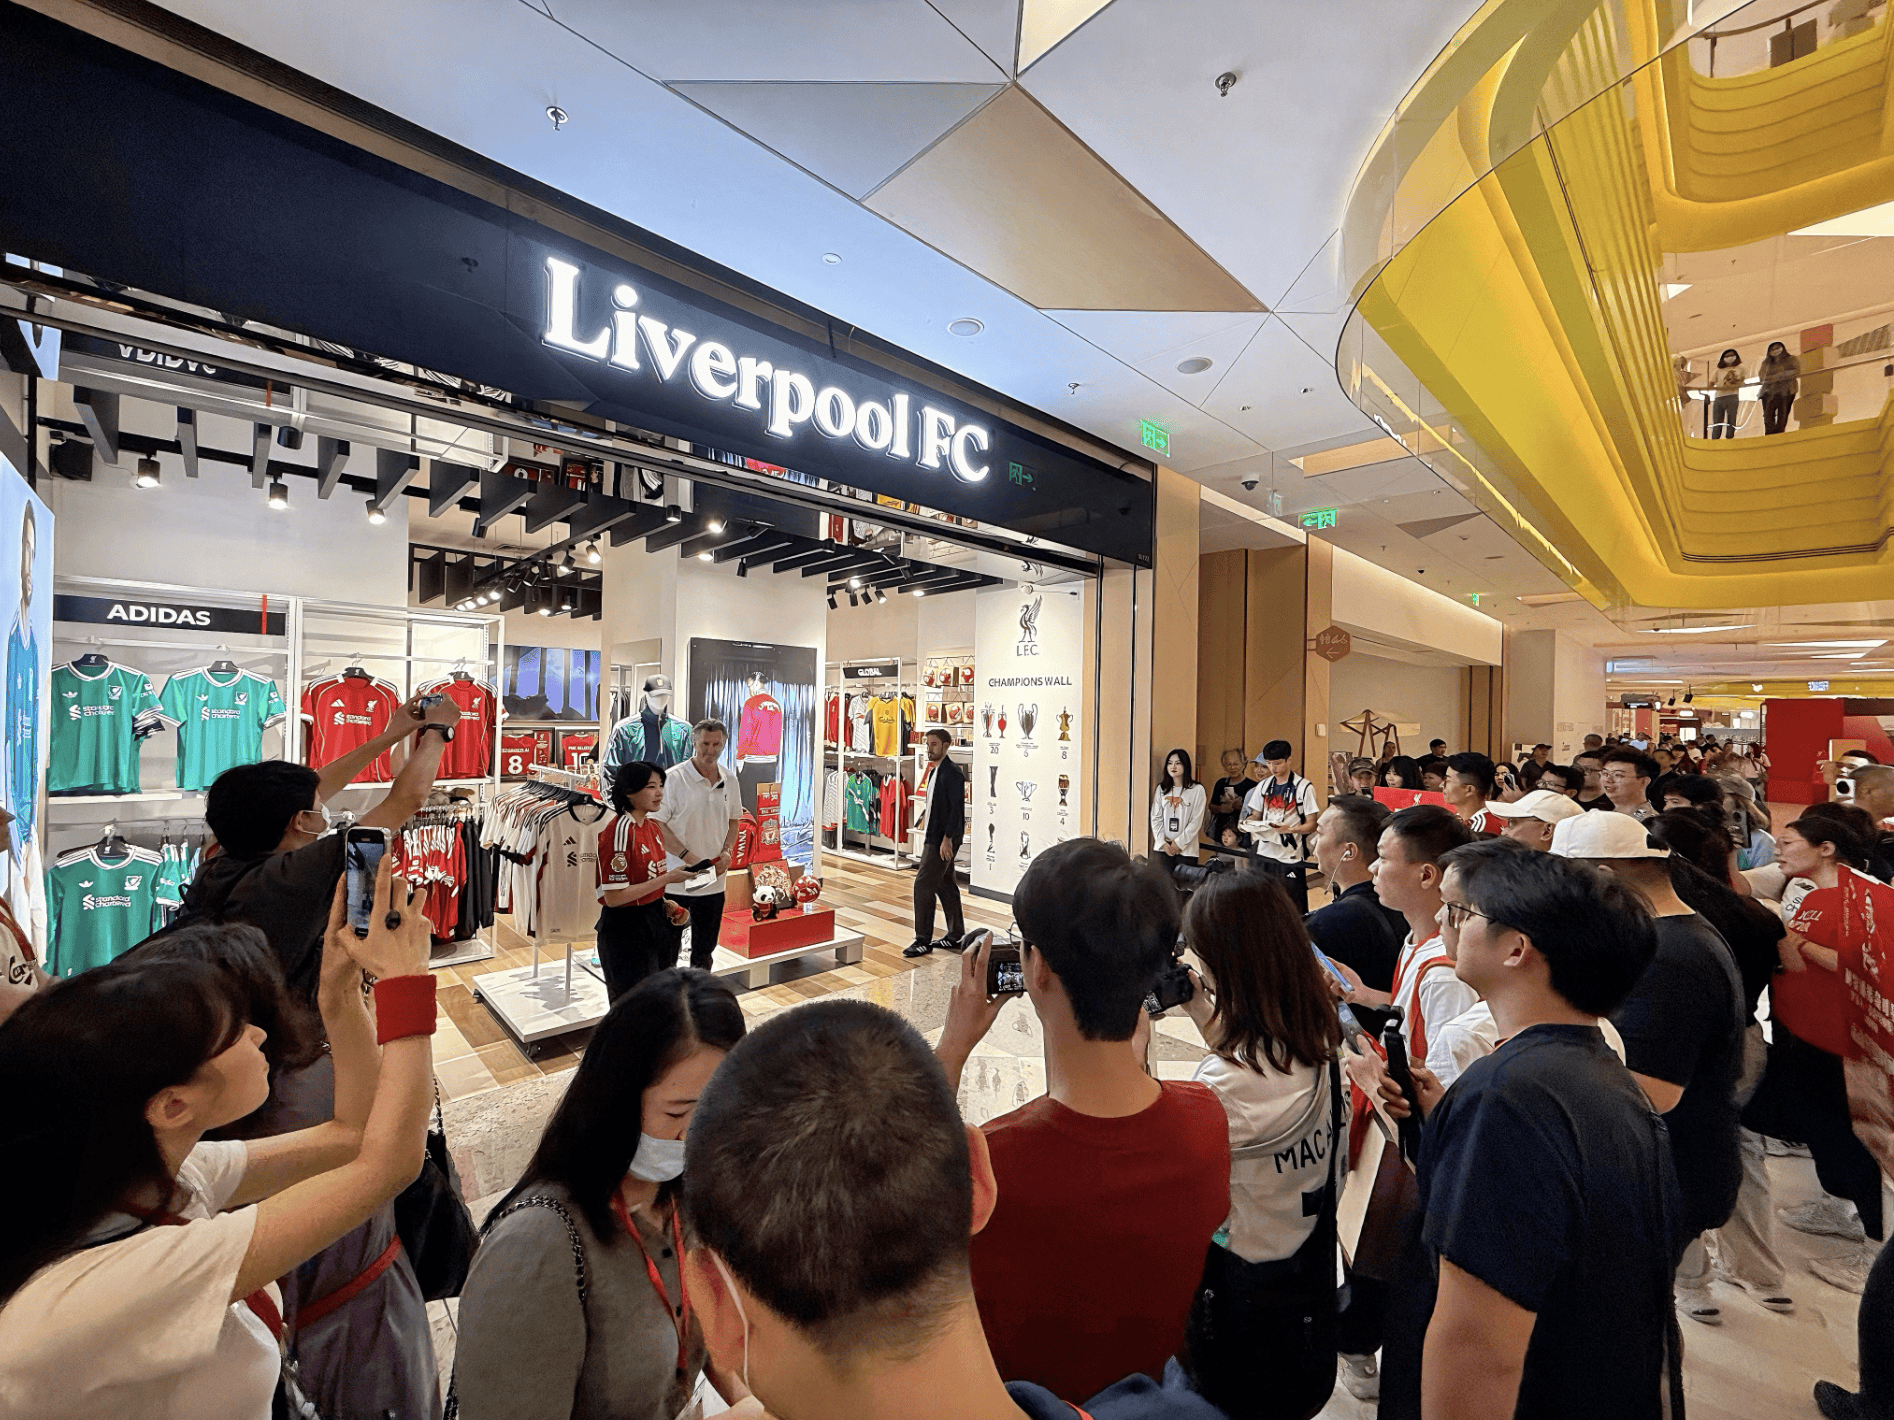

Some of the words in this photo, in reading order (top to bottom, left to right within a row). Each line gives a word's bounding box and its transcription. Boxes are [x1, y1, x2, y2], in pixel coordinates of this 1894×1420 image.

[544, 257, 910, 460] Liverpool
[917, 406, 990, 483] FC
[106, 604, 211, 626] ADIDAS
[988, 677, 1043, 688] CHAMPIONS
[1044, 676, 1072, 686] WALL
[990, 746, 999, 754] 20
[1023, 750, 1029, 758] 6
[1061, 751, 1067, 760] 8
[507, 755, 523, 775] 8
[1022, 812, 1030, 820] 10
[1060, 817, 1065, 825] 4
[736, 829, 747, 858] YNWA
